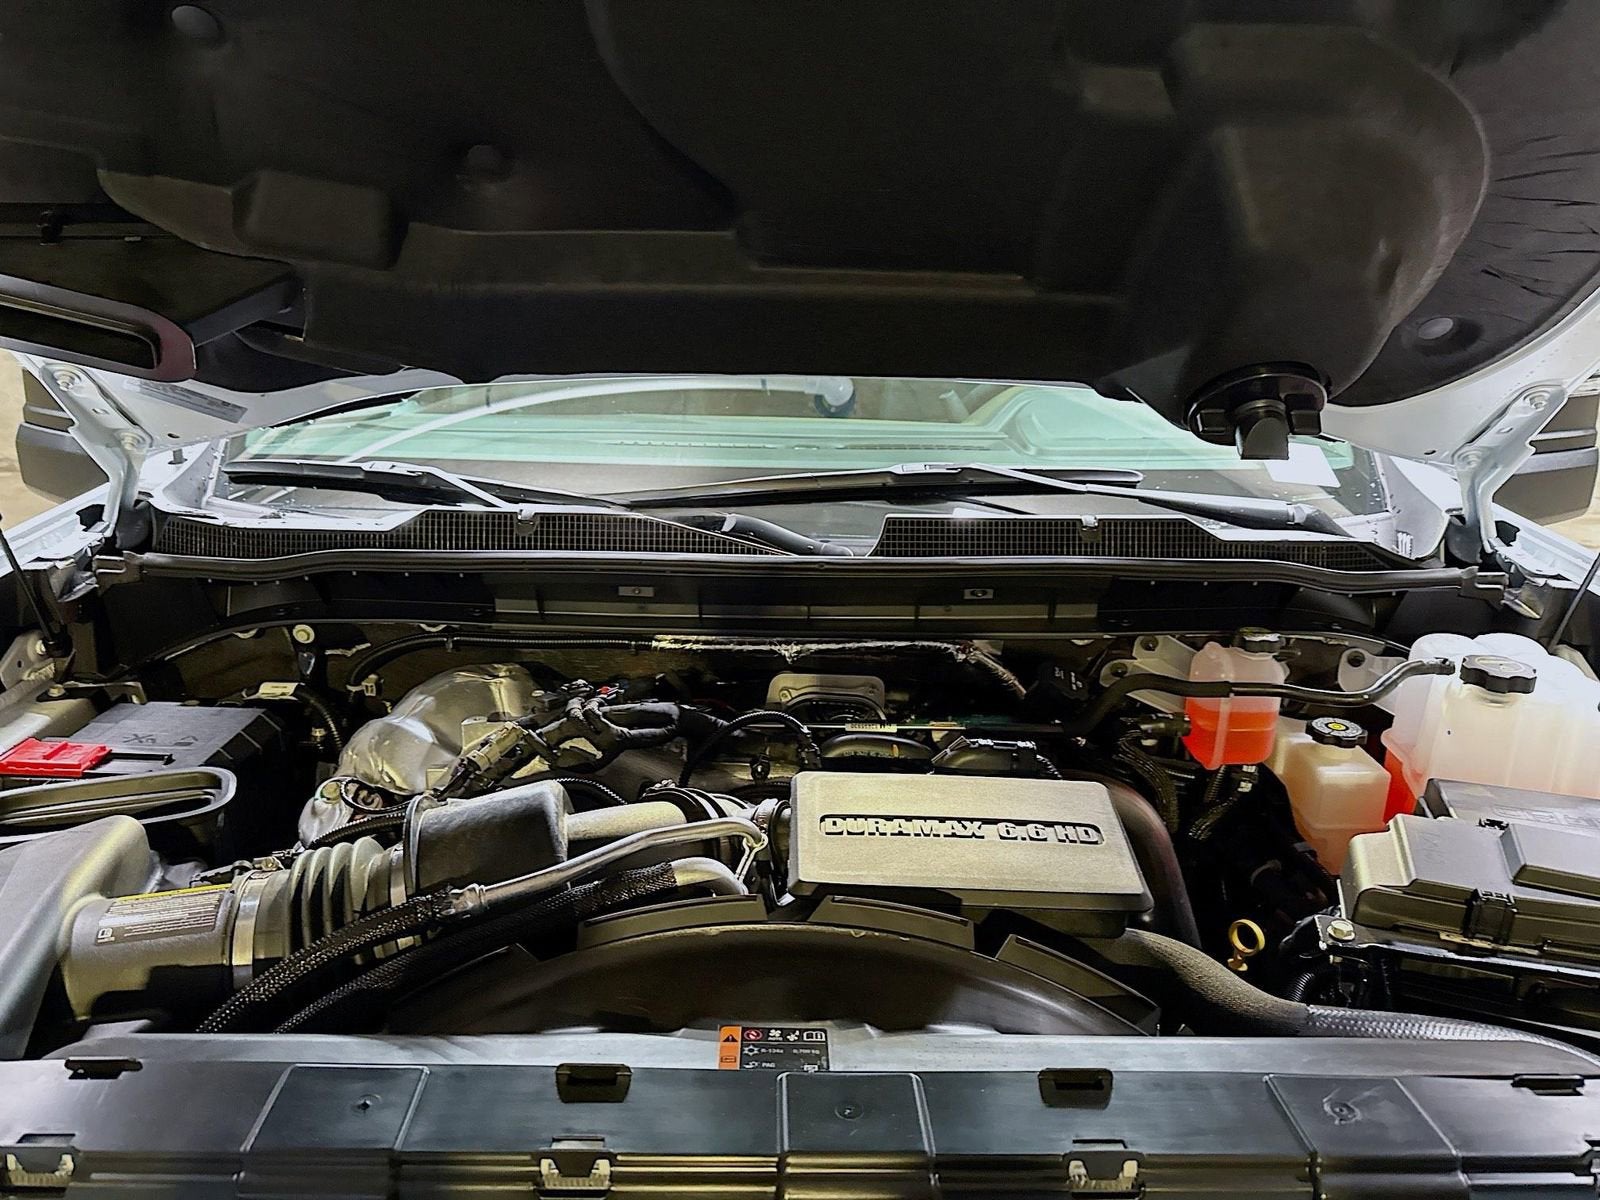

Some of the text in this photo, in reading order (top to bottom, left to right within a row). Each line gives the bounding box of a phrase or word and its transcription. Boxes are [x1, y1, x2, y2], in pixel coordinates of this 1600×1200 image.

[824, 817, 1101, 844] DURAMAX 6.6 HD
